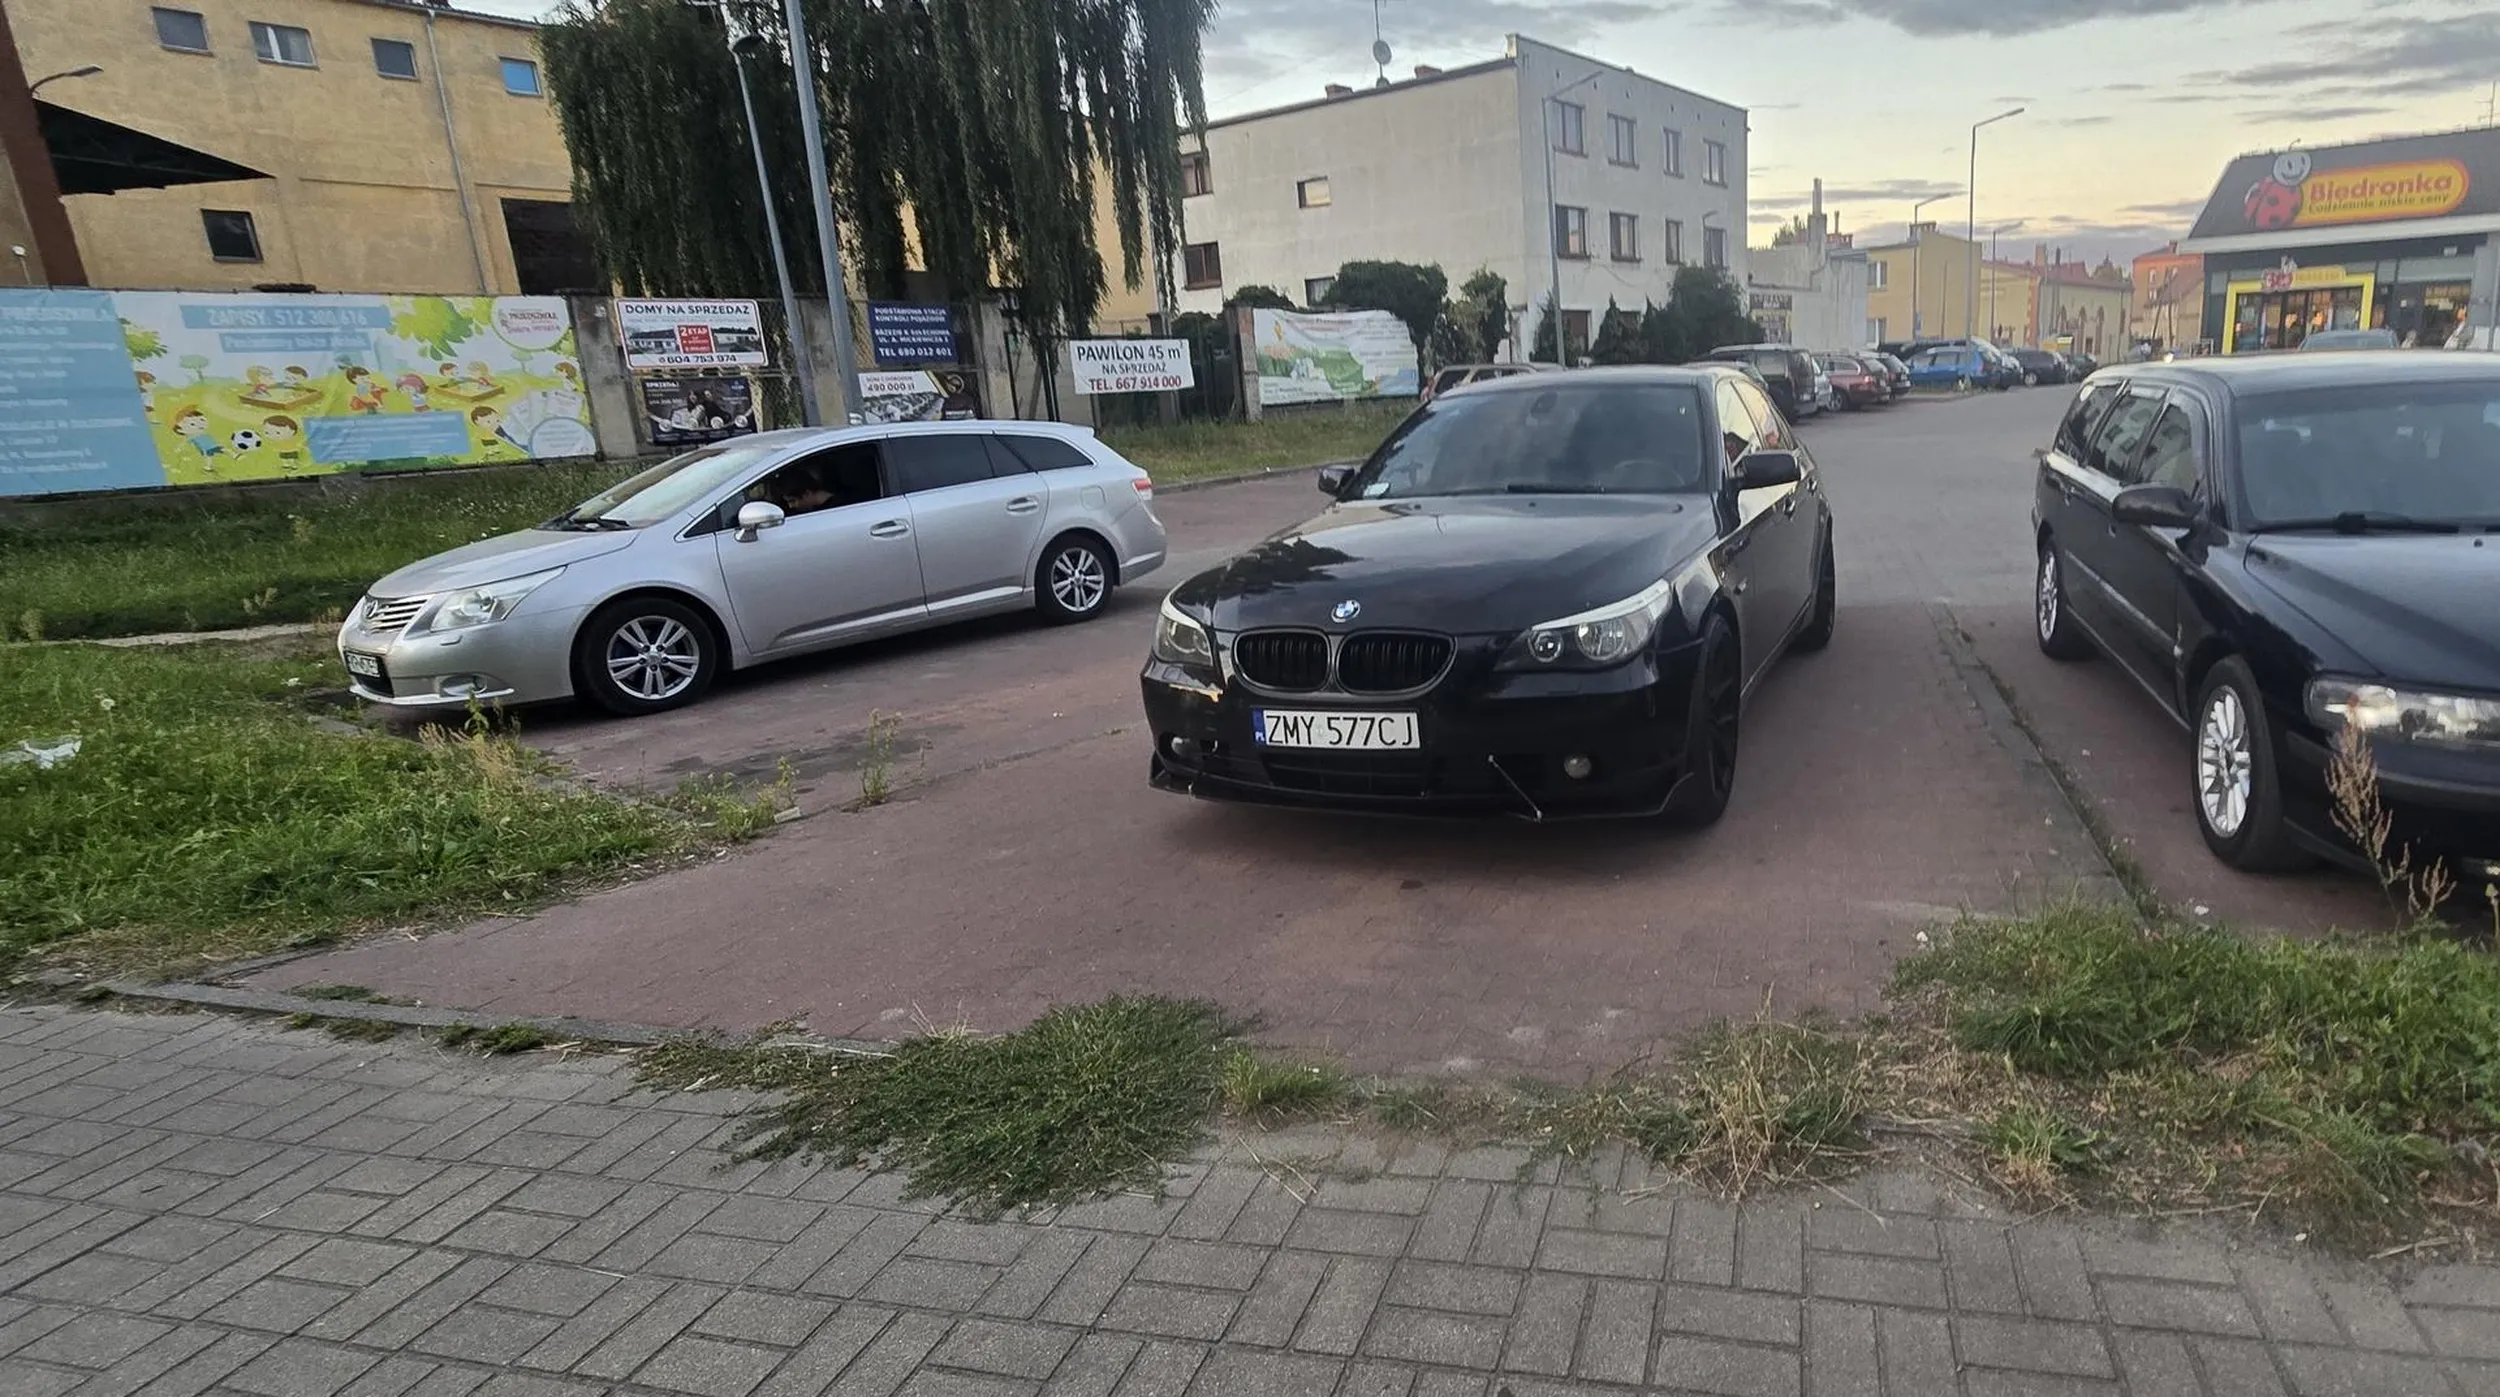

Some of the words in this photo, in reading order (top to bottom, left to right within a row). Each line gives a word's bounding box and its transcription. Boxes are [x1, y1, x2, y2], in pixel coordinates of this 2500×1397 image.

[2310, 173, 2452, 203] Biedronka
[625, 305, 662, 315] DOMY
[667, 305, 686, 315] NA
[679, 327, 687, 337] 2
[1077, 345, 1145, 361] PAWILON
[1148, 345, 1165, 359] 45
[1102, 363, 1118, 375] NA
[887, 382, 906, 392] 000
[1089, 378, 1113, 391] TEL.
[1116, 377, 1137, 390] 667
[1140, 376, 1159, 388] 914
[1162, 375, 1182, 387] 000
[1266, 715, 1315, 745] ZMY
[1327, 716, 1412, 746] 577CJ
